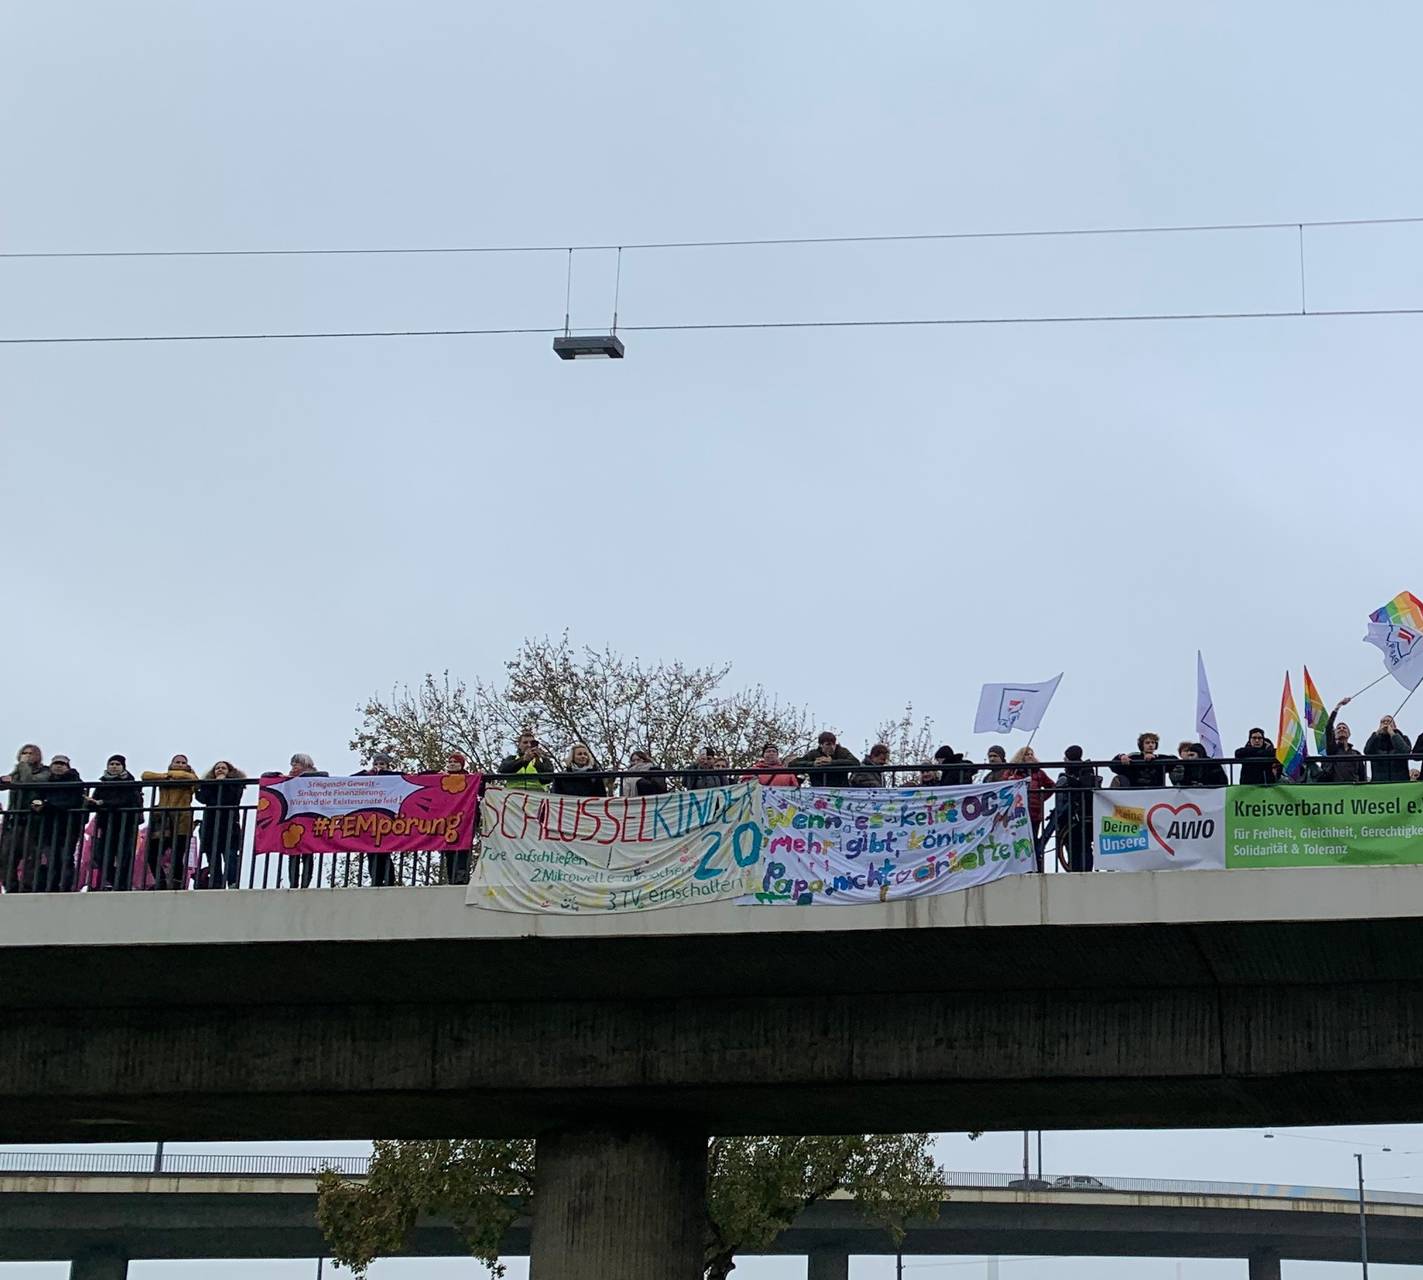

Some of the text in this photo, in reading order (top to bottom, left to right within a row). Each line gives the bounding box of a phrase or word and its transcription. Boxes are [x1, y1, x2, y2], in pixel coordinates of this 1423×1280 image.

[1235, 799, 1344, 817] Kreisverband
[1351, 797, 1400, 815] Wesel
[768, 806, 842, 830] Wenn
[313, 812, 464, 847] #FEMpörung
[1104, 821, 1138, 834] Deine
[1166, 819, 1215, 840] AWO
[1234, 828, 1250, 840] für
[1253, 827, 1297, 841] Freiheit,
[1300, 826, 1357, 840] Gleichheit,
[1103, 837, 1147, 851] Unsere
[1234, 842, 1349, 857] Solidarität & Toleranz
